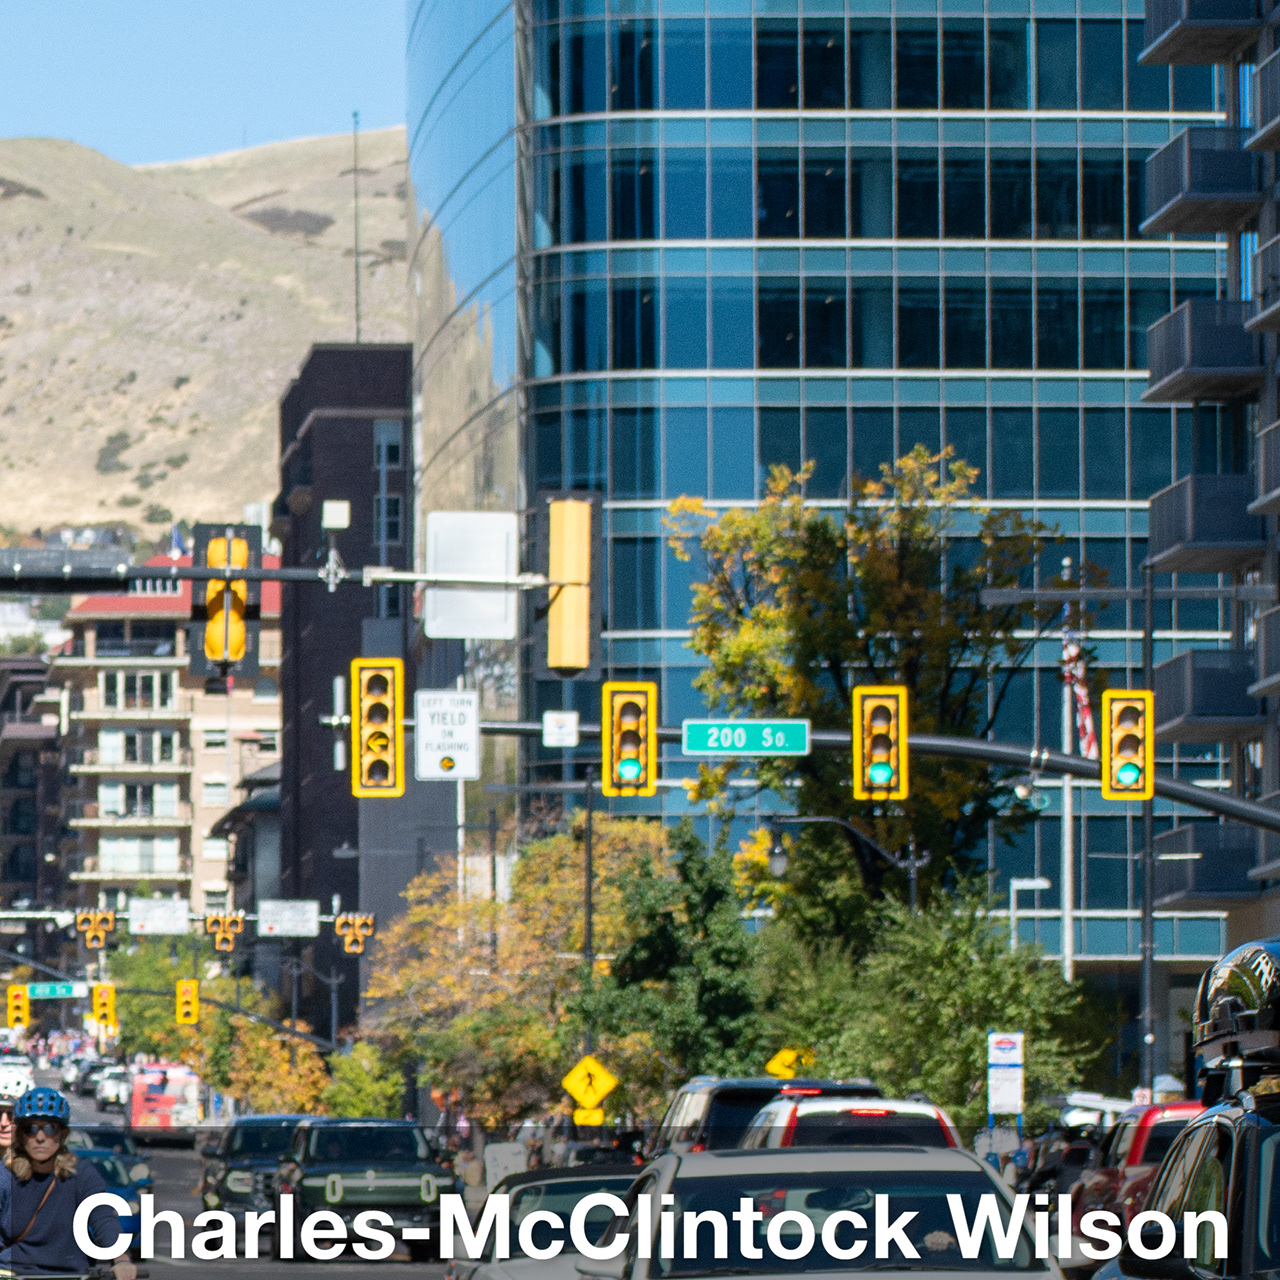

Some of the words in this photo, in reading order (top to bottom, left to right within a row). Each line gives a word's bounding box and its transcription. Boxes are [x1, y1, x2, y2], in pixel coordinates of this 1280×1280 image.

[428, 711, 466, 726] YIELD
[440, 729, 454, 739] ON
[706, 726, 747, 748] 200
[761, 726, 790, 748] So.
[424, 742, 470, 752] FLASHING
